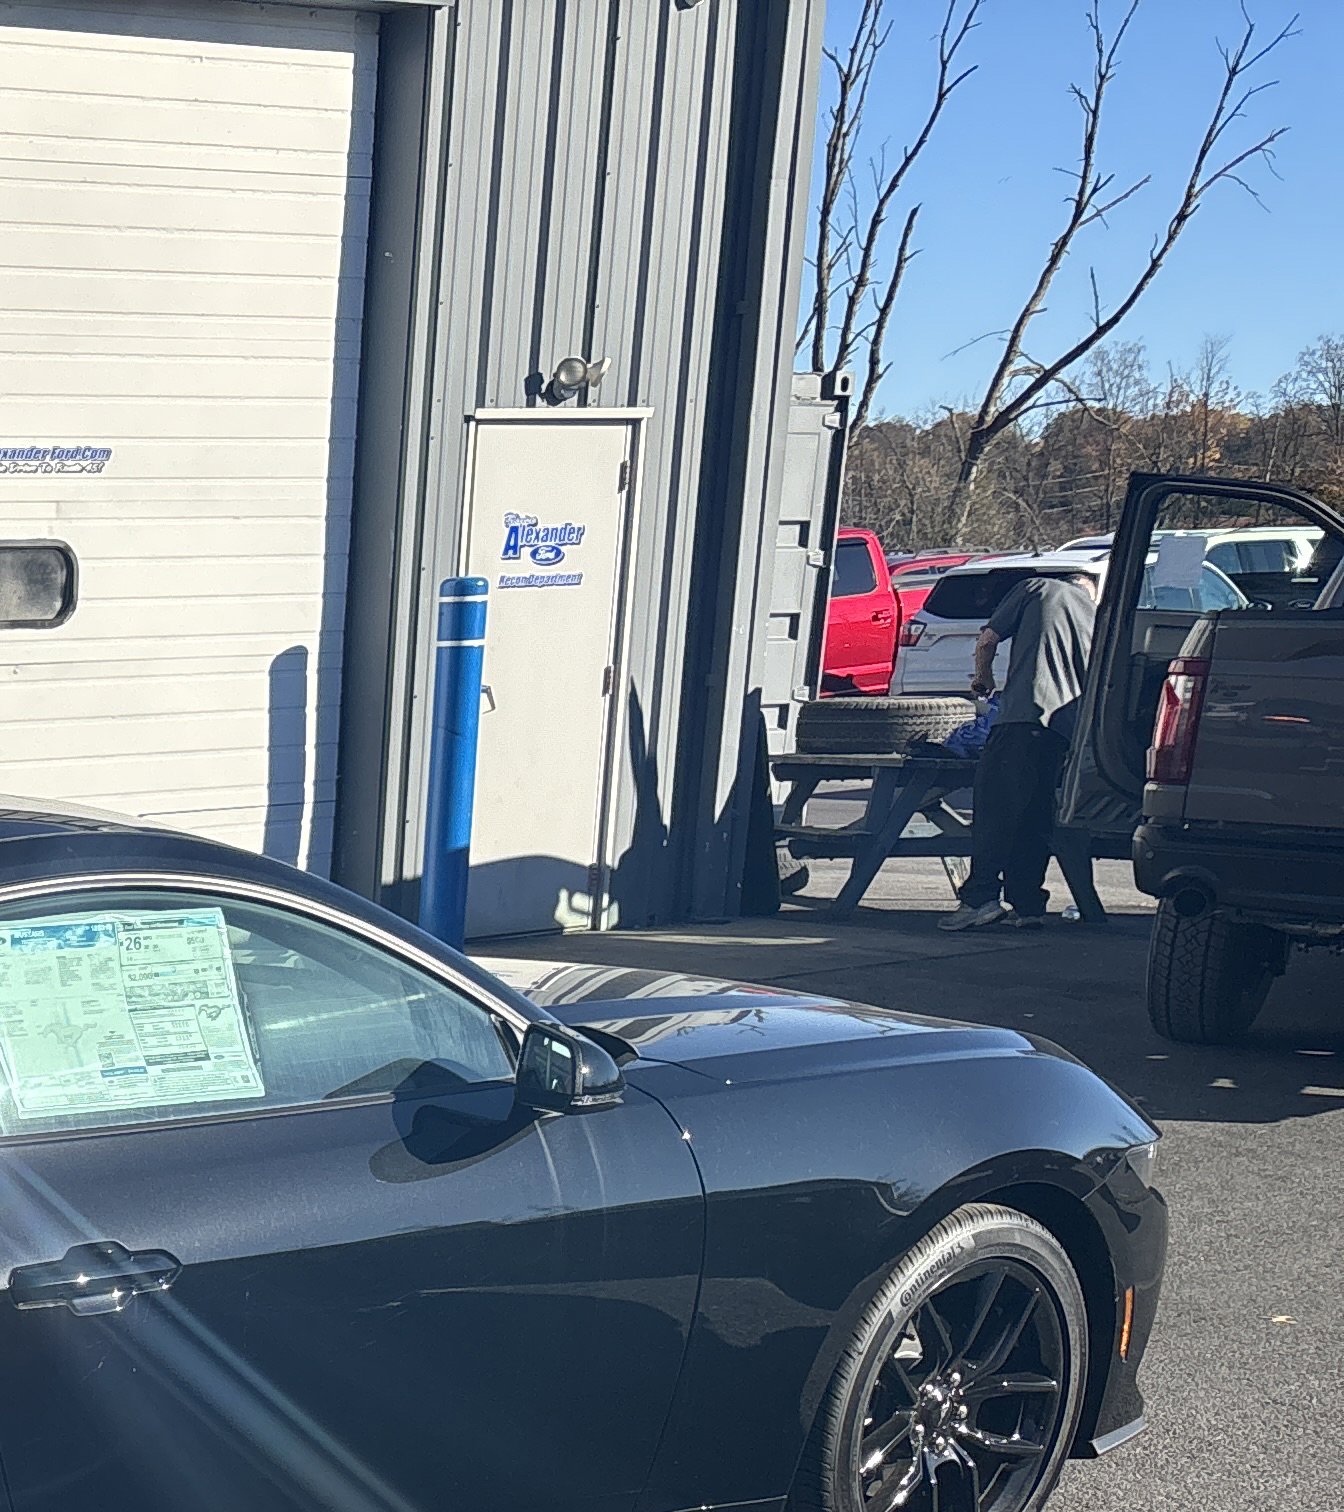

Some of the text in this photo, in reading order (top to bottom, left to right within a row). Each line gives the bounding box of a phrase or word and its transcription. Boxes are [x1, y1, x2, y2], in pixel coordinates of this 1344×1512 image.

[502, 524, 584, 556] Alexander
[125, 936, 142, 951] 26
[900, 1245, 958, 1307] Continental
